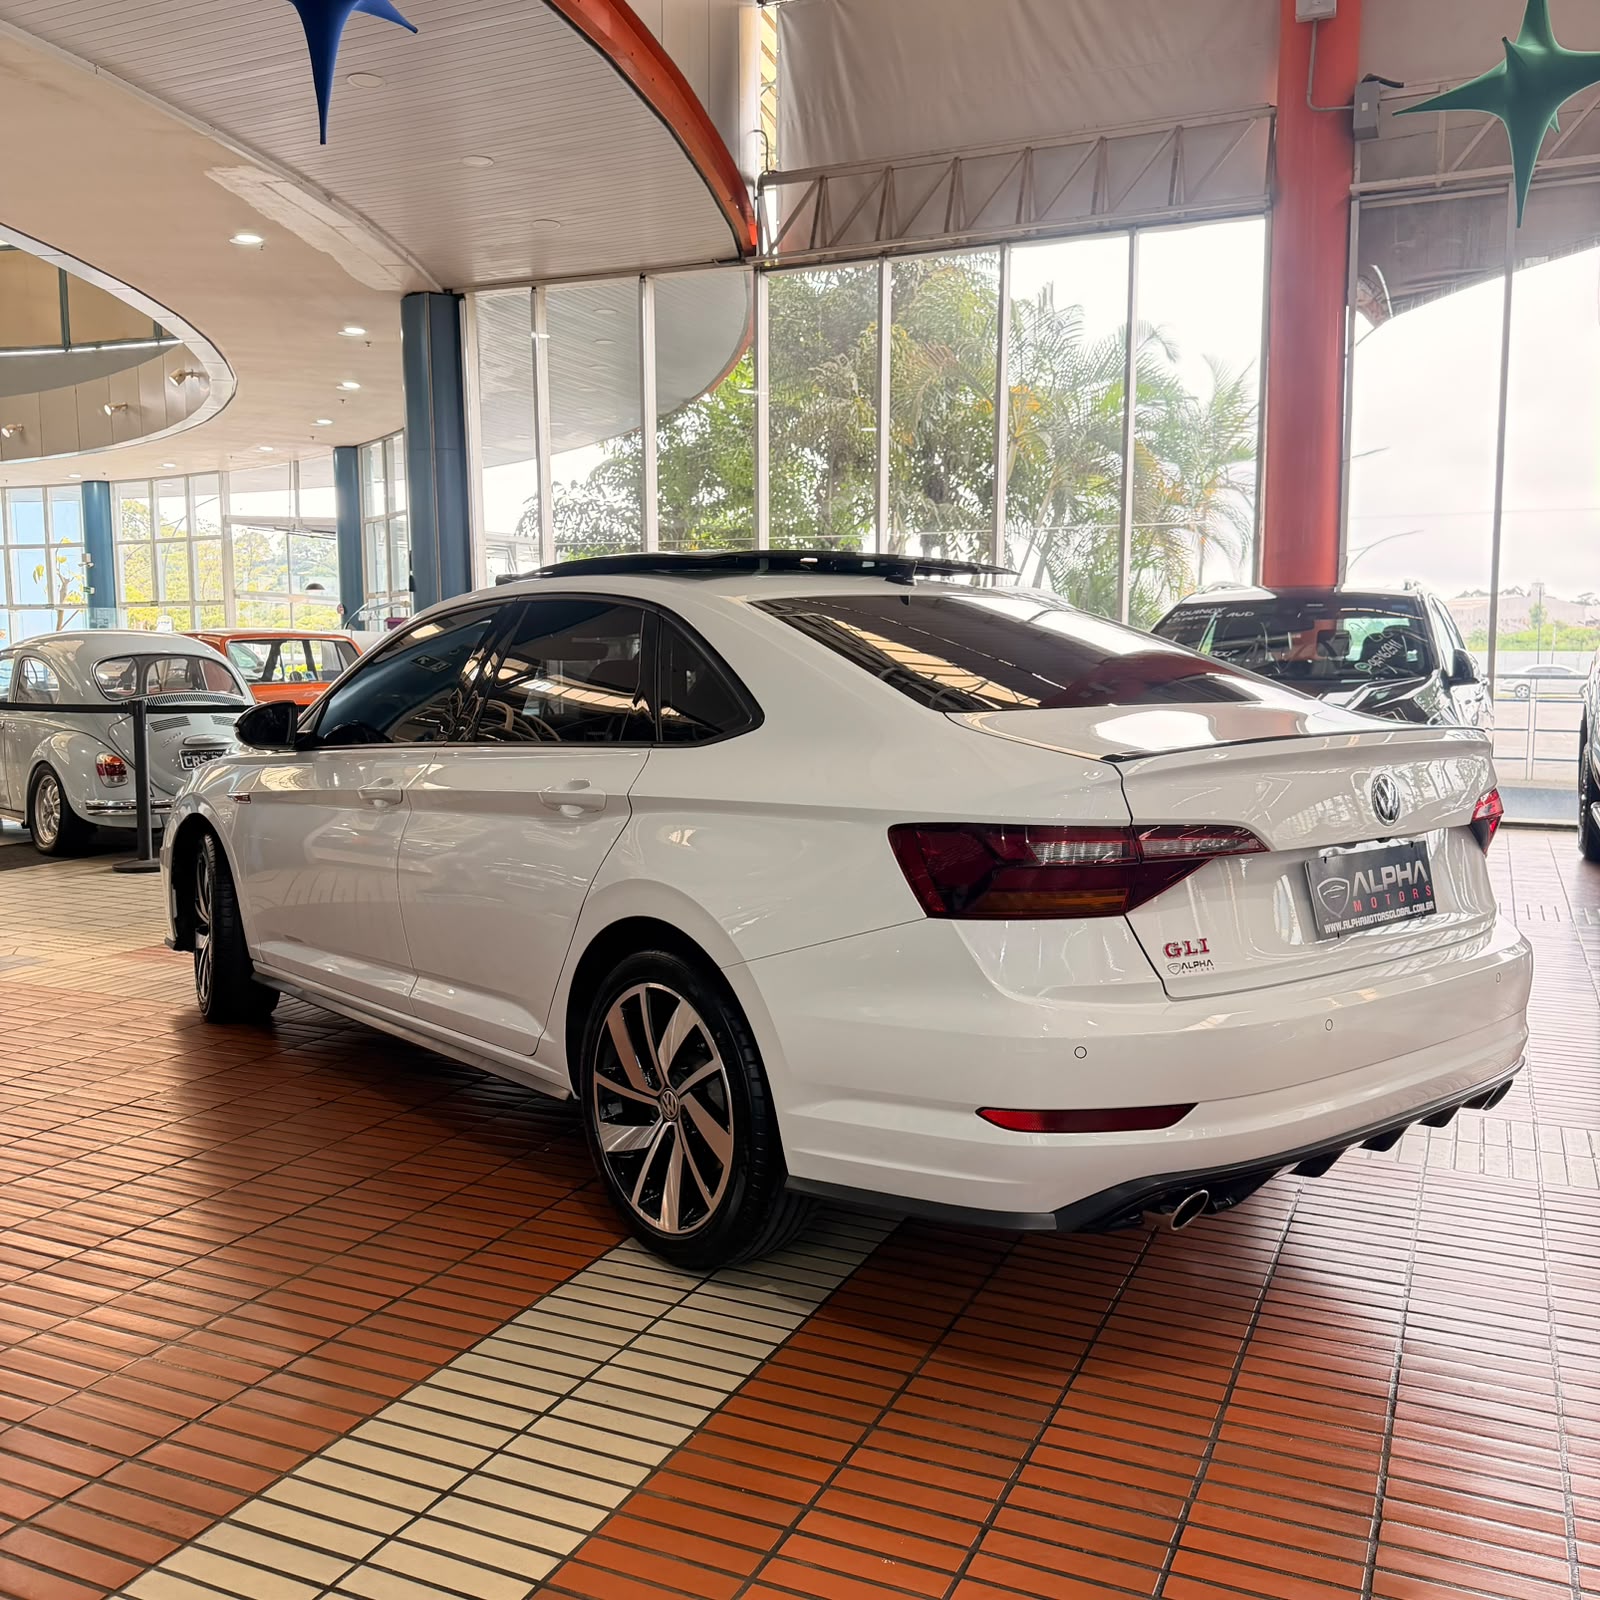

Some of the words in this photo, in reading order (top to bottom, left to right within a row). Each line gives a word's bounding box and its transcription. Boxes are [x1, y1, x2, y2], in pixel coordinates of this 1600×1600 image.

[1352, 859, 1429, 897] ALPHA
[1352, 885, 1432, 912] MOTORS
[1163, 938, 1210, 959] GLI
[1181, 959, 1214, 970] ALPHA
